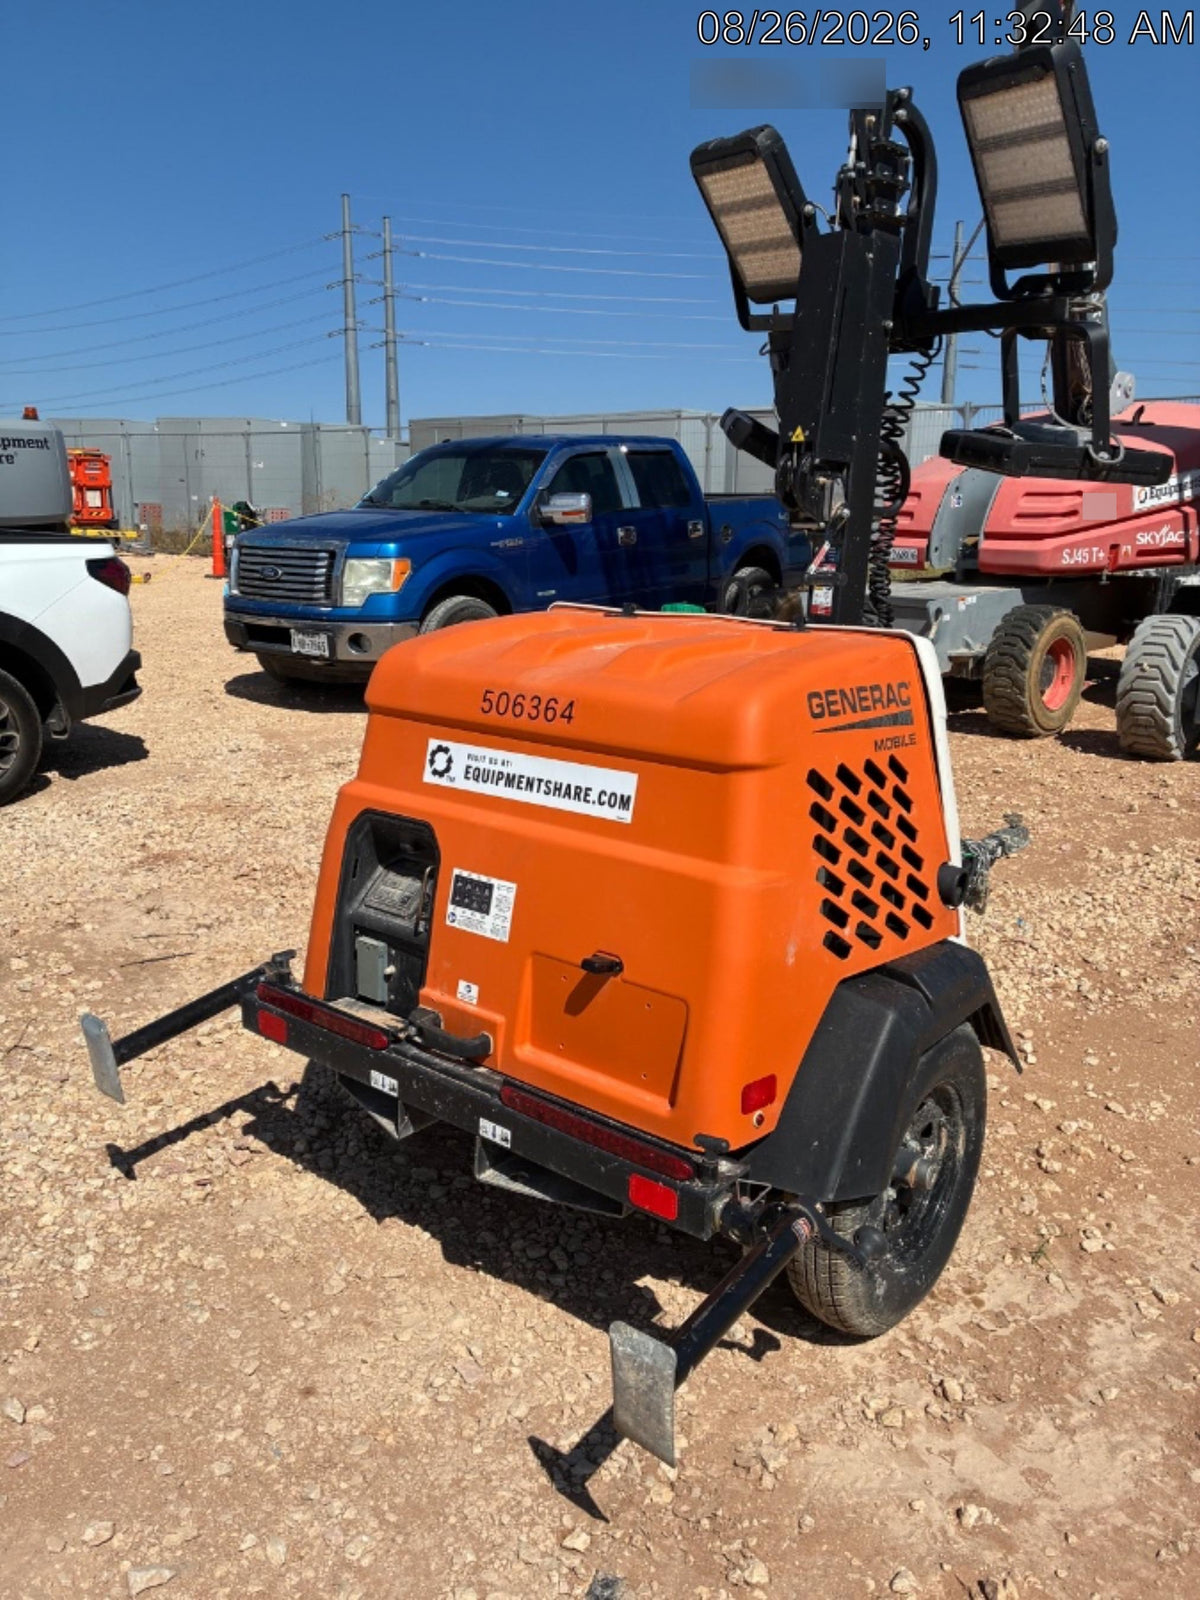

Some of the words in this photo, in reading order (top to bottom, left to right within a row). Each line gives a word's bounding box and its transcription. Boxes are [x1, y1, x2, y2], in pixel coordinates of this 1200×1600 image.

[0, 437, 50, 450] pment
[481, 689, 576, 724] 506364
[807, 681, 911, 719] GENERAC
[874, 733, 916, 752] MOBILE
[464, 765, 632, 811] EQUIPMENTSHARE.COM
